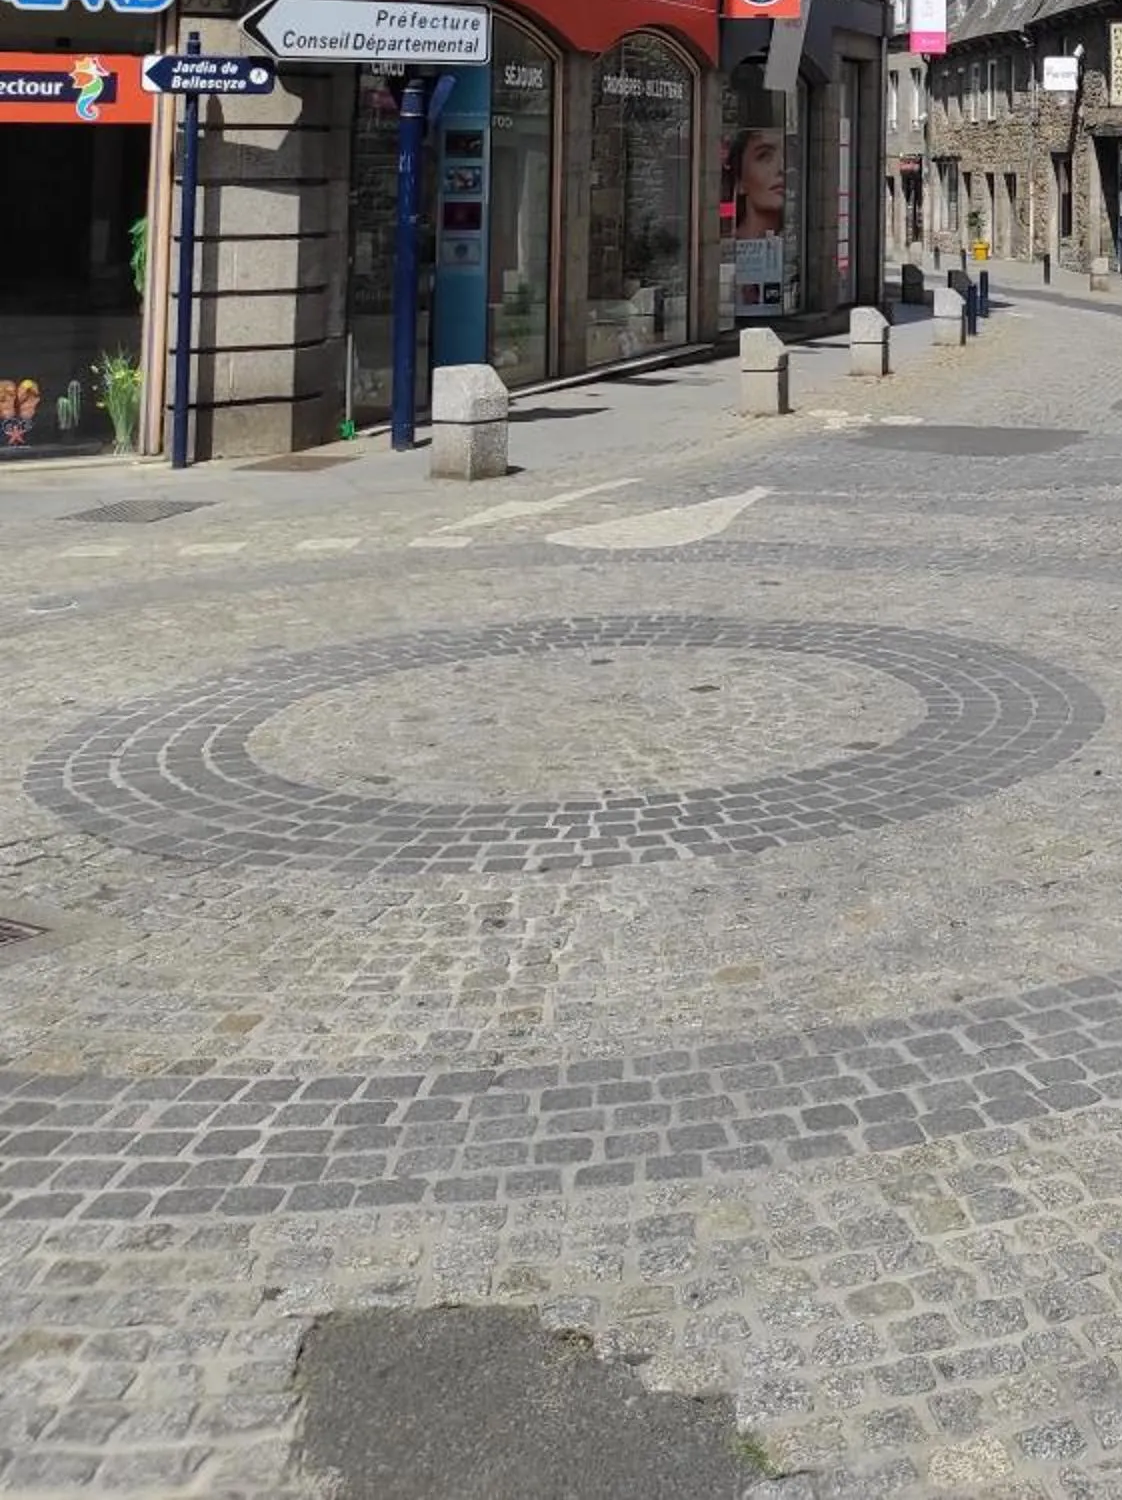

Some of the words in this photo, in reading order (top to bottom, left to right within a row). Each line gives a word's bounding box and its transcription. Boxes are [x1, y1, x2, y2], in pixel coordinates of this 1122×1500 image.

[376, 9, 481, 31] Préfecture
[282, 30, 351, 50] Conseil
[353, 33, 479, 56] Départemental
[172, 61, 217, 74] Jardin
[221, 62, 239, 75] de
[504, 62, 543, 89] SÉJOURS
